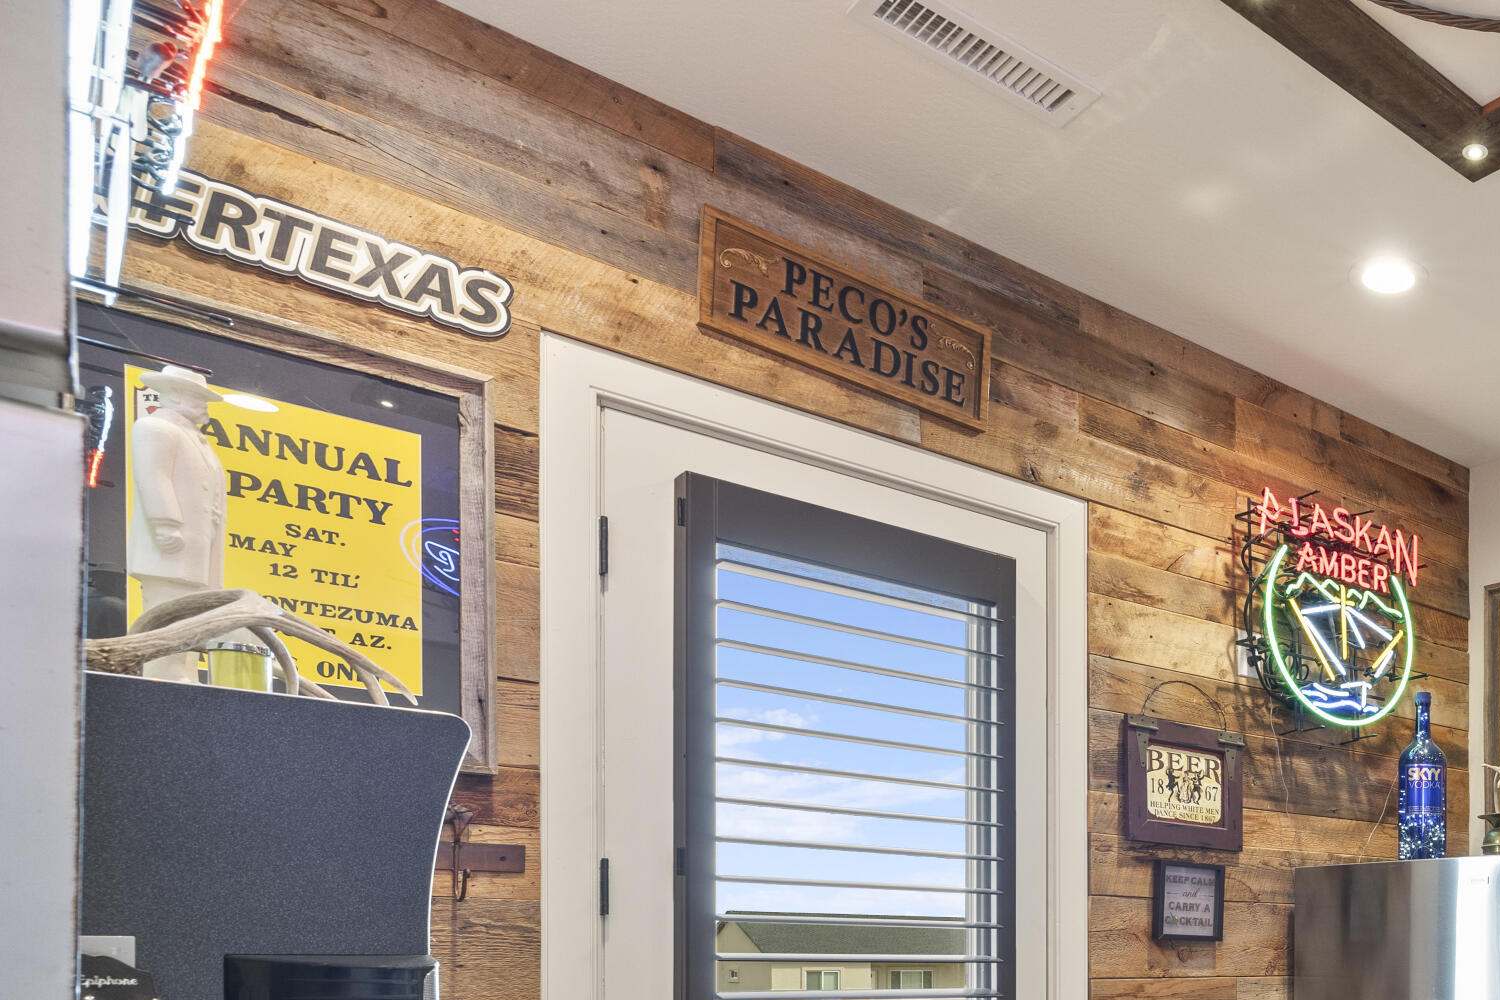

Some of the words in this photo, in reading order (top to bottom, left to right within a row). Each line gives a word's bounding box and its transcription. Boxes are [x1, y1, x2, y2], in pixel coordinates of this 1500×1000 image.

[780, 256, 928, 351] PECO'S
[727, 278, 966, 407] PARADISE
[200, 418, 413, 488] ANNUAL
[226, 469, 393, 526] PARTY
[228, 532, 297, 558] MAY
[284, 523, 347, 546] SAT.
[1256, 486, 1419, 588] ALASKAN
[269, 563, 299, 579] 12
[1296, 541, 1389, 593] AMBER
[263, 595, 419, 632] ONTEZUMA
[349, 632, 393, 650] AZ.
[1147, 749, 1221, 785] BEER
[1407, 767, 1441, 781] SKYY
[1151, 777, 1165, 795] 18
[1205, 785, 1218, 802] 67
[1408, 780, 1441, 789] VODKA
[1150, 800, 1181, 811] HELPING
[1183, 805, 1204, 814] WHITE
[1205, 807, 1220, 815] MEN
[1154, 808, 1177, 818] DANCE
[1179, 811, 1199, 820] SINCE
[1166, 875, 1190, 885] KEEP
[1182, 887, 1200, 897] and
[1168, 901, 1201, 912] CARRY
[1204, 904, 1211, 913] A
[1165, 915, 1212, 928] CCKTAIL
